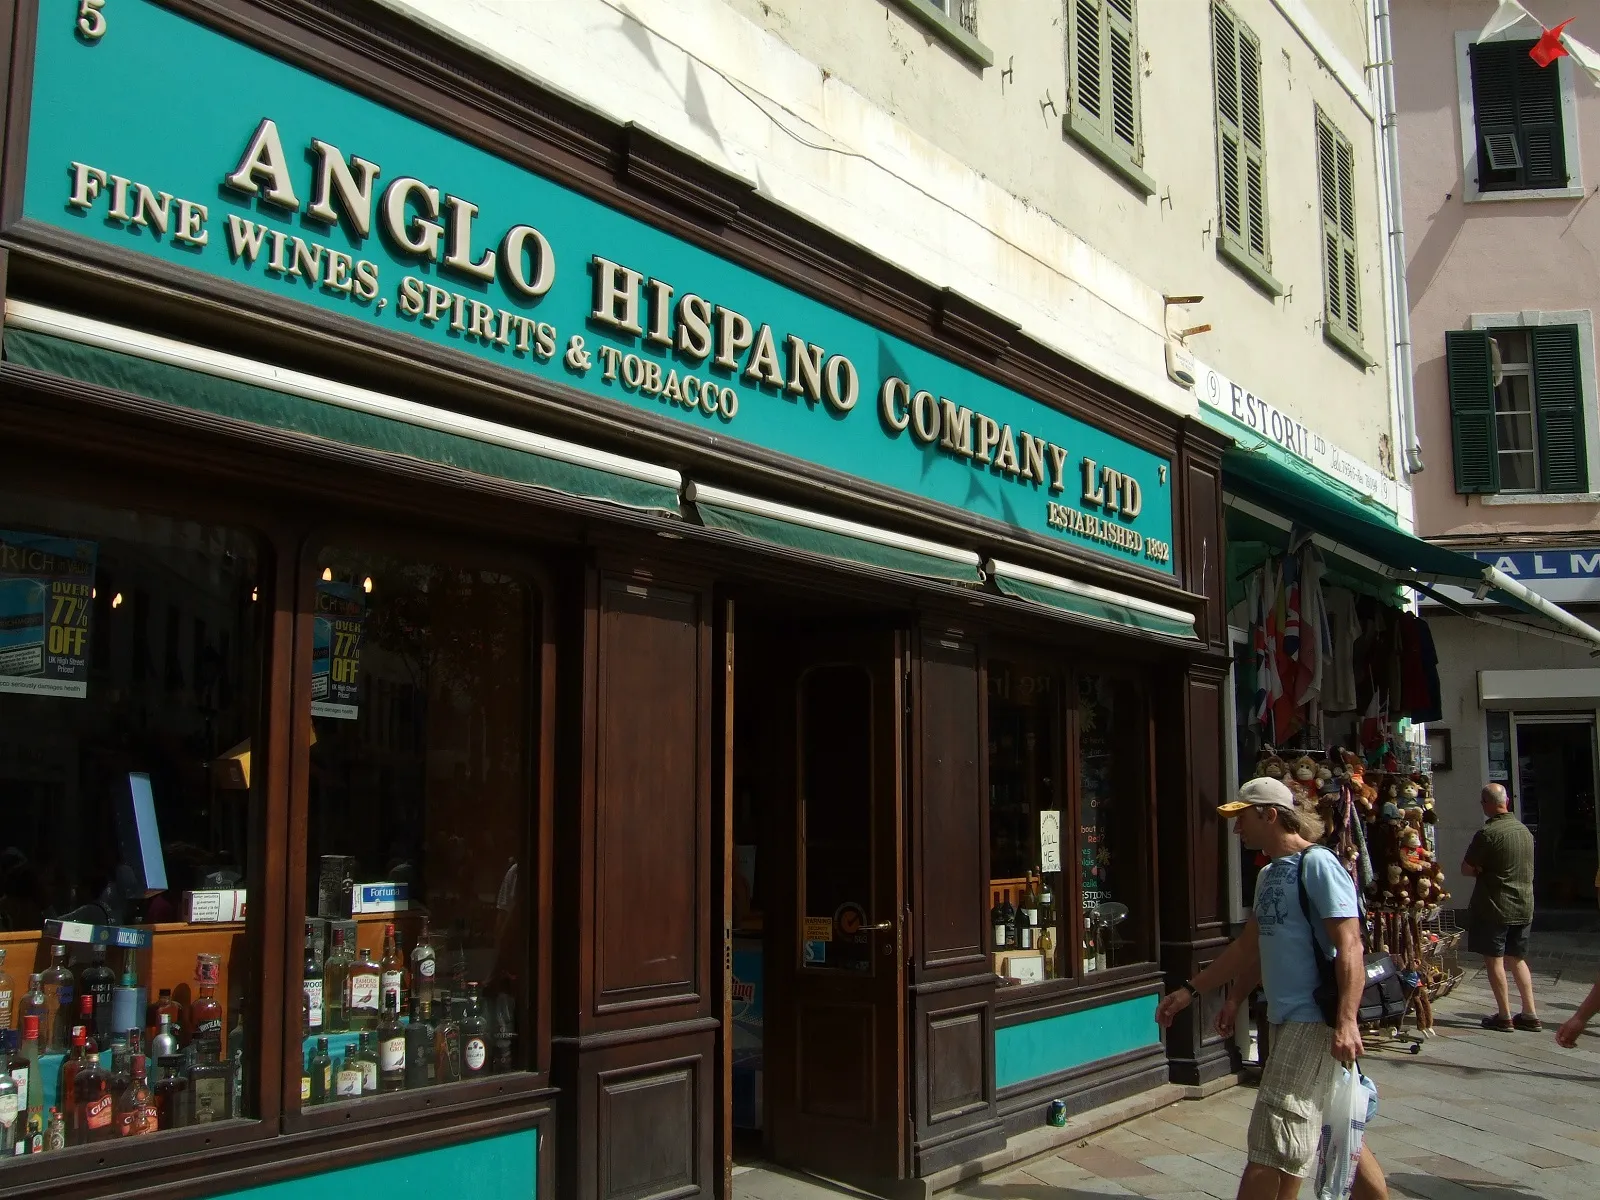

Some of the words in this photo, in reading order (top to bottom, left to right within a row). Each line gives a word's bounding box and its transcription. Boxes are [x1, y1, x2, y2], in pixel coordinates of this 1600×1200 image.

[78, 0, 106, 38] 5
[69, 161, 209, 246] FINE
[227, 214, 389, 309] WINES,
[399, 276, 557, 361] SPIRITS
[565, 334, 592, 371] &
[599, 345, 738, 421] TOBACCO
[226, 117, 556, 297] ANGLO
[591, 255, 859, 412] HISPANO
[882, 375, 1068, 491] COMPANY
[1083, 457, 1142, 518] LTD
[1229, 381, 1314, 463] ESTORIL
[1158, 464, 1167, 485] 7
[1048, 501, 1143, 552] ESTABLISHED
[1145, 537, 1170, 561] 1892
[51, 581, 89, 598] OVER
[50, 596, 89, 628] 77%
[335, 620, 361, 633] OVER
[47, 626, 88, 657] OFF
[333, 632, 361, 659] 77%
[331, 658, 360, 684] OFF
[11, 681, 37, 691] seriously
[38, 683, 63, 692] damages
[64, 684, 81, 693] health
[370, 887, 400, 898] Fortuna
